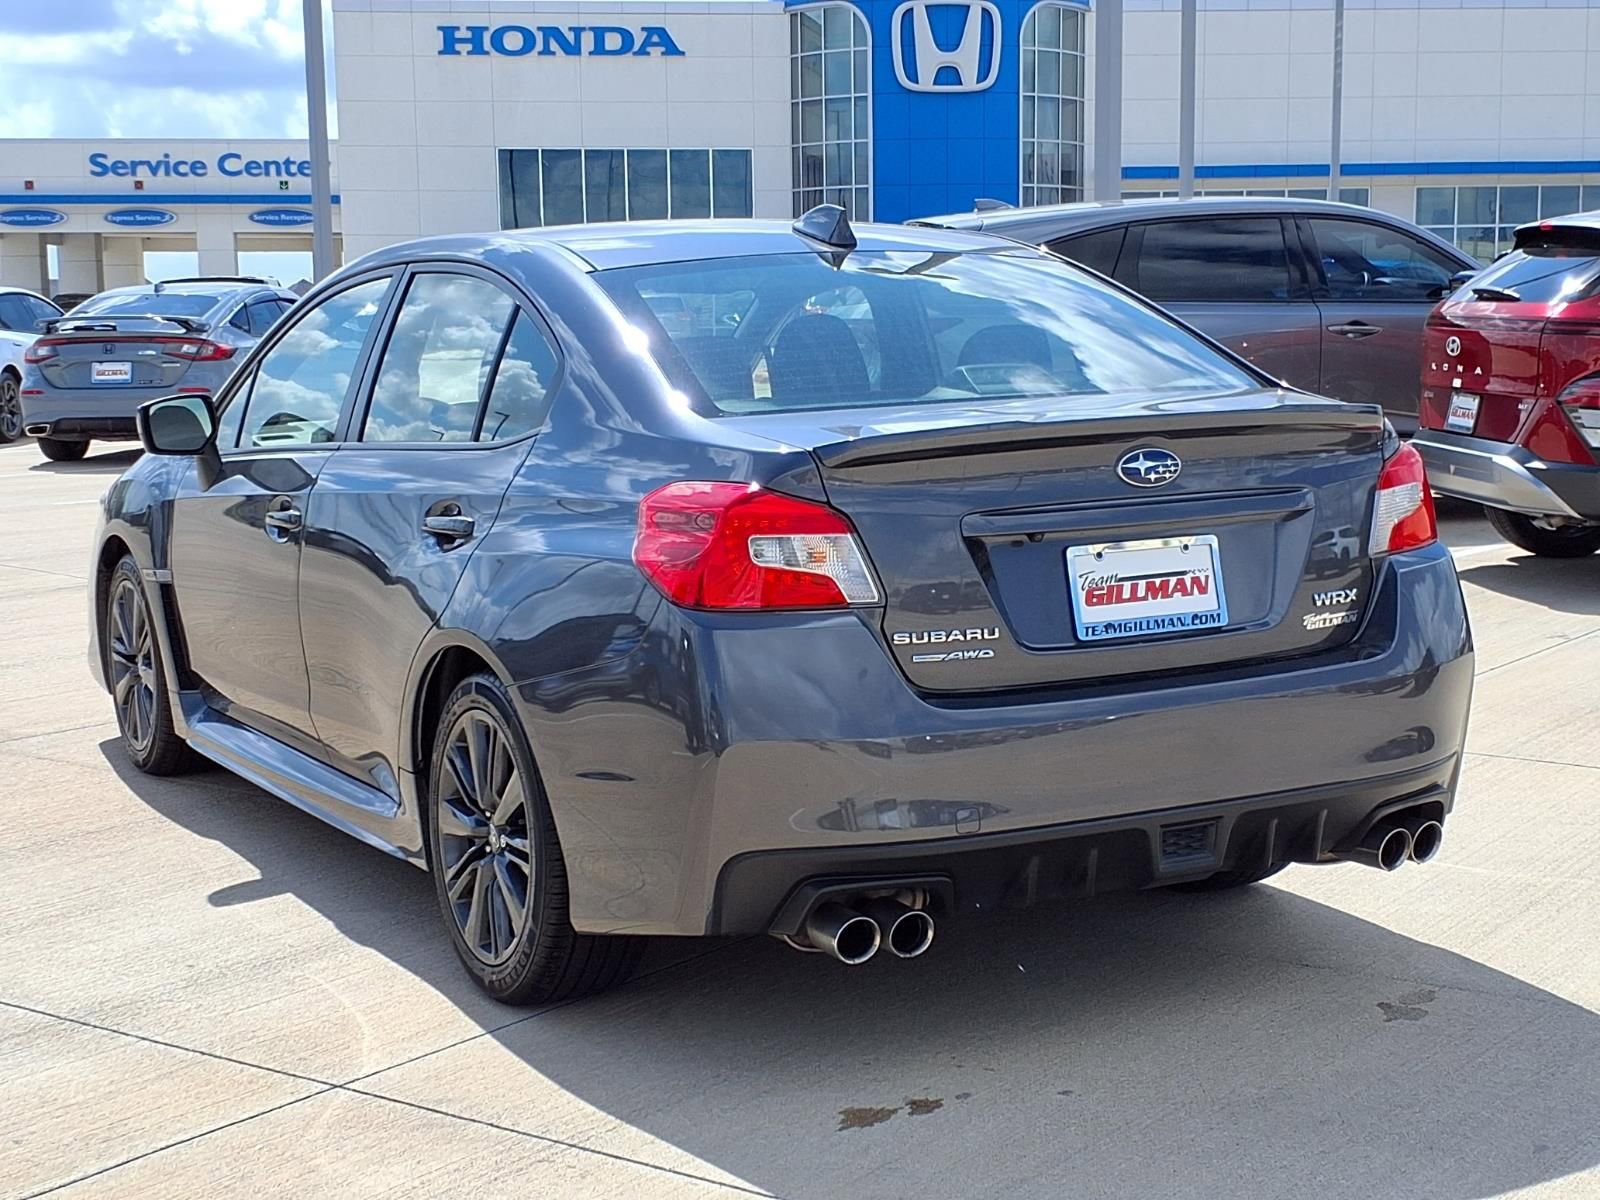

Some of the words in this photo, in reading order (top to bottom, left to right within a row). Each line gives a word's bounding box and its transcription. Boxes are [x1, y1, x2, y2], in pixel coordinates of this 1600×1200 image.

[437, 25, 686, 57] HONDA
[89, 153, 208, 178] Service
[217, 153, 312, 178] Cente
[1078, 571, 1119, 591] Team
[1085, 575, 1210, 607] GILLMAN
[1313, 588, 1358, 607] WRX
[893, 627, 1000, 645] SUBARU
[1083, 613, 1221, 638] TEAMGILLMAN.COM
[943, 649, 995, 661] AWD
